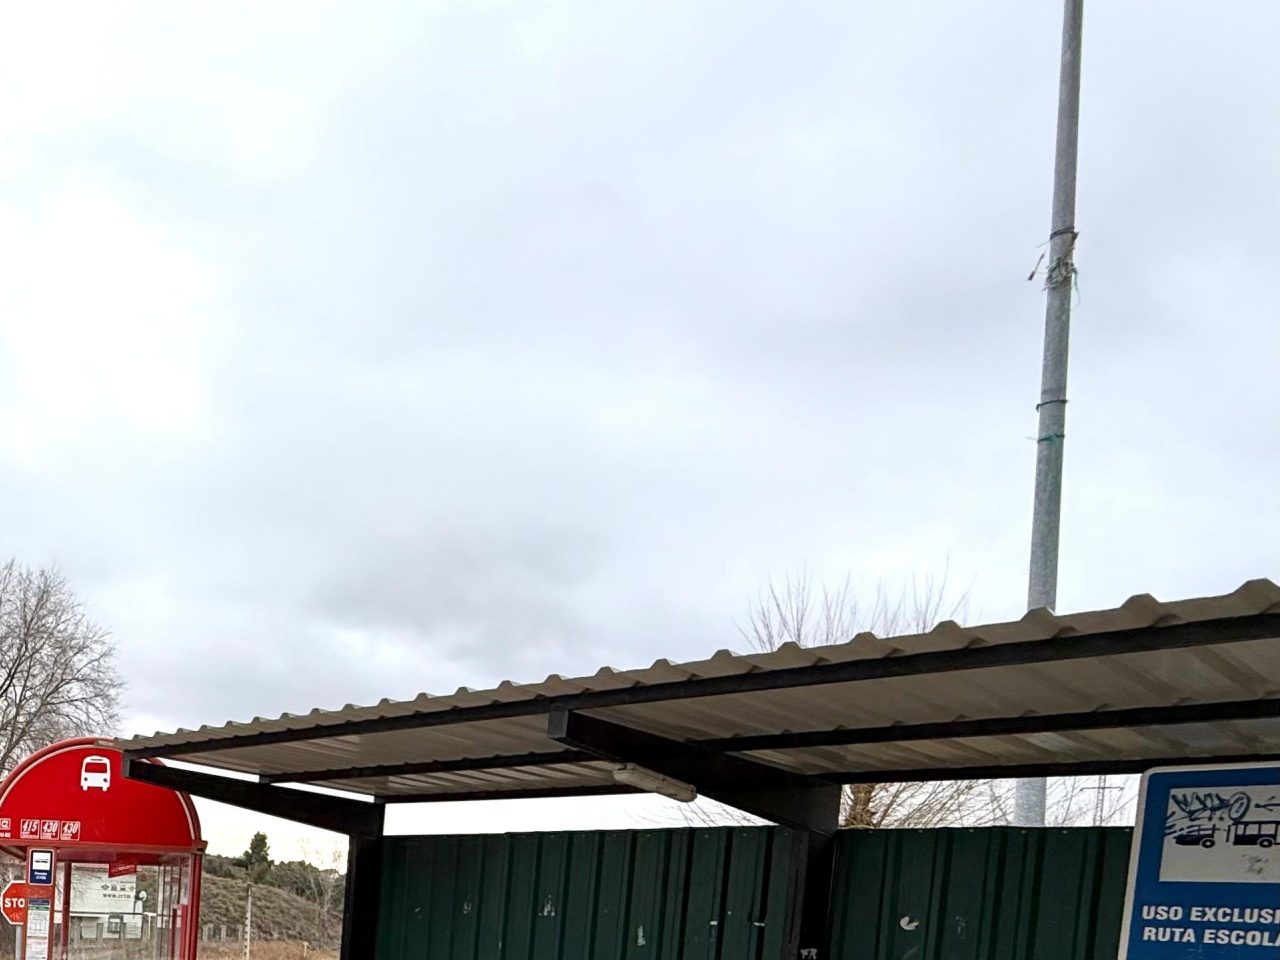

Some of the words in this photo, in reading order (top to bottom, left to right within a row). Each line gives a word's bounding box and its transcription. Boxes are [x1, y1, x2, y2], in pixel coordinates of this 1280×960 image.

[22, 820, 38, 832] 415
[42, 821, 58, 833] 430
[62, 822, 79, 834] 430
[4, 897, 26, 908] STO
[1142, 905, 1183, 921] USO
[1142, 926, 1196, 943] RUTA
